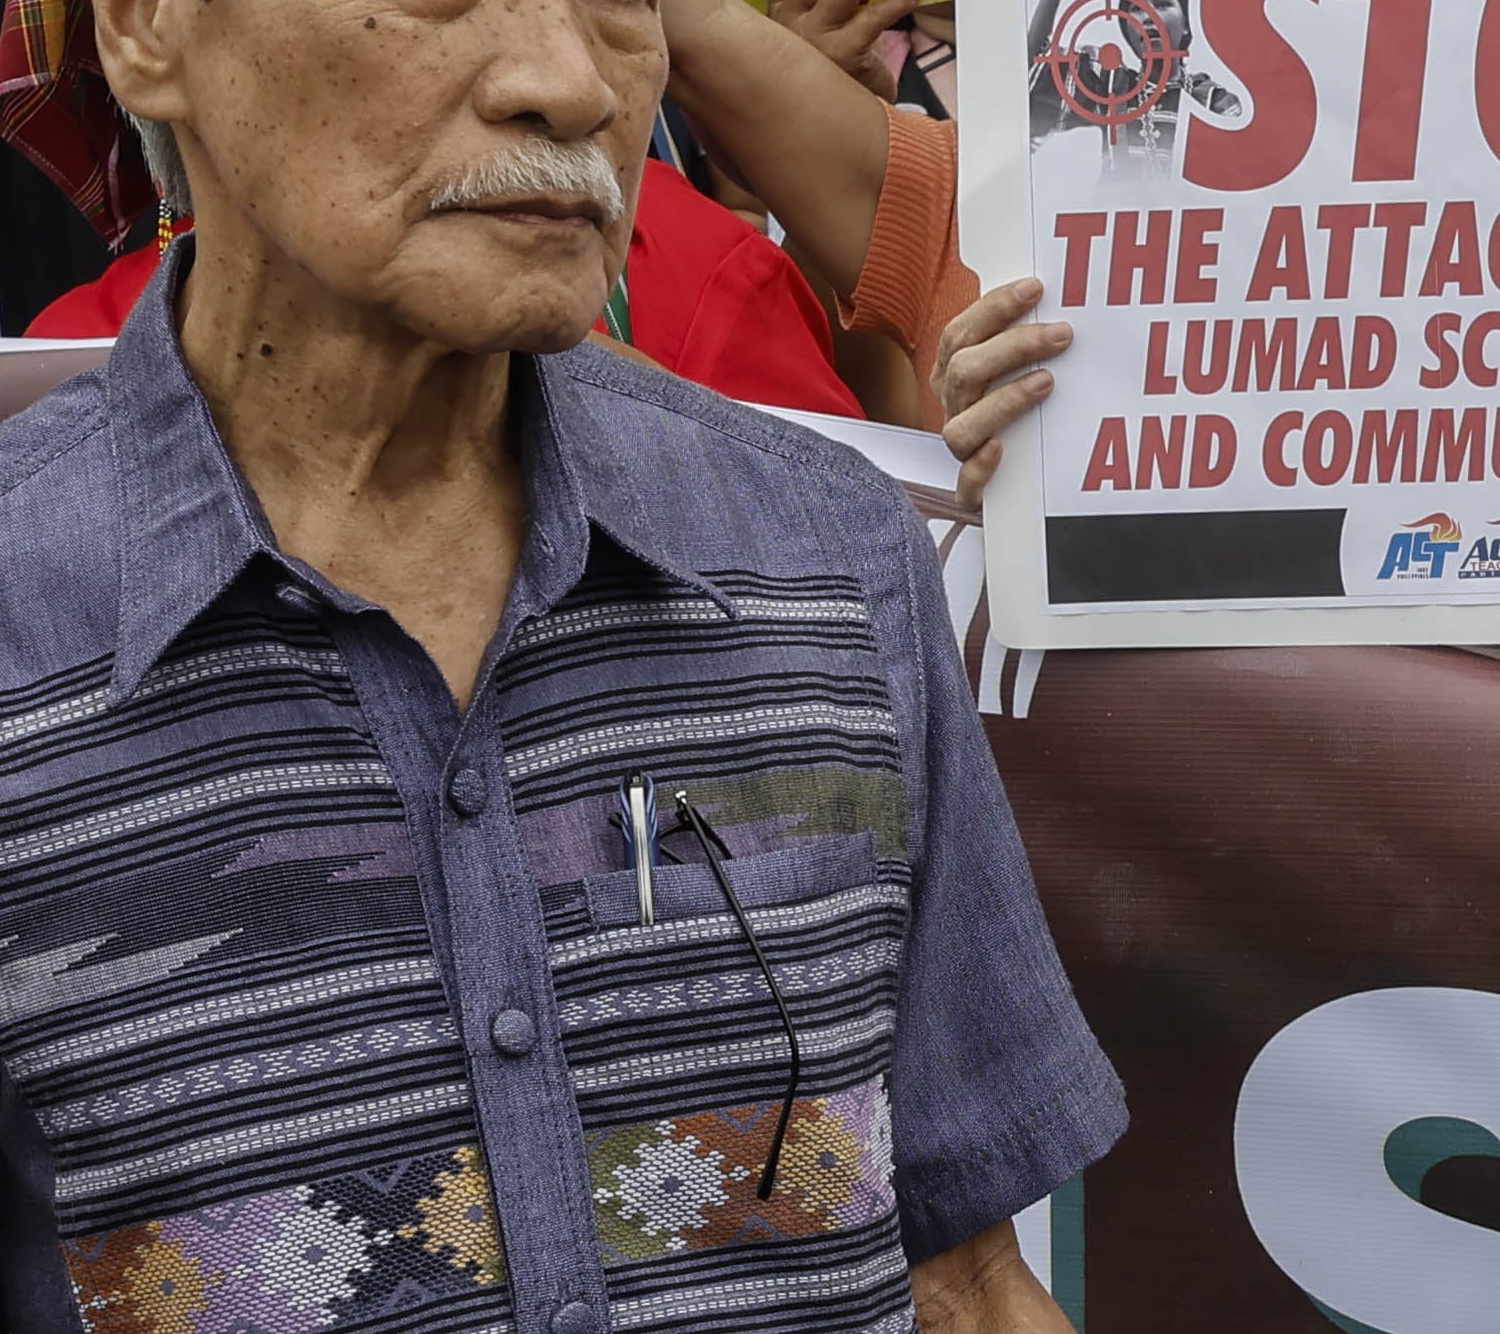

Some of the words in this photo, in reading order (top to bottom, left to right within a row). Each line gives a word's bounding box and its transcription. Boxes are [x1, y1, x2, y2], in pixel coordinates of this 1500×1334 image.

[1053, 207, 1224, 308] THE
[1143, 313, 1398, 395] LUMAD
[1081, 409, 1239, 492] AND
[1376, 531, 1460, 580] ACT
